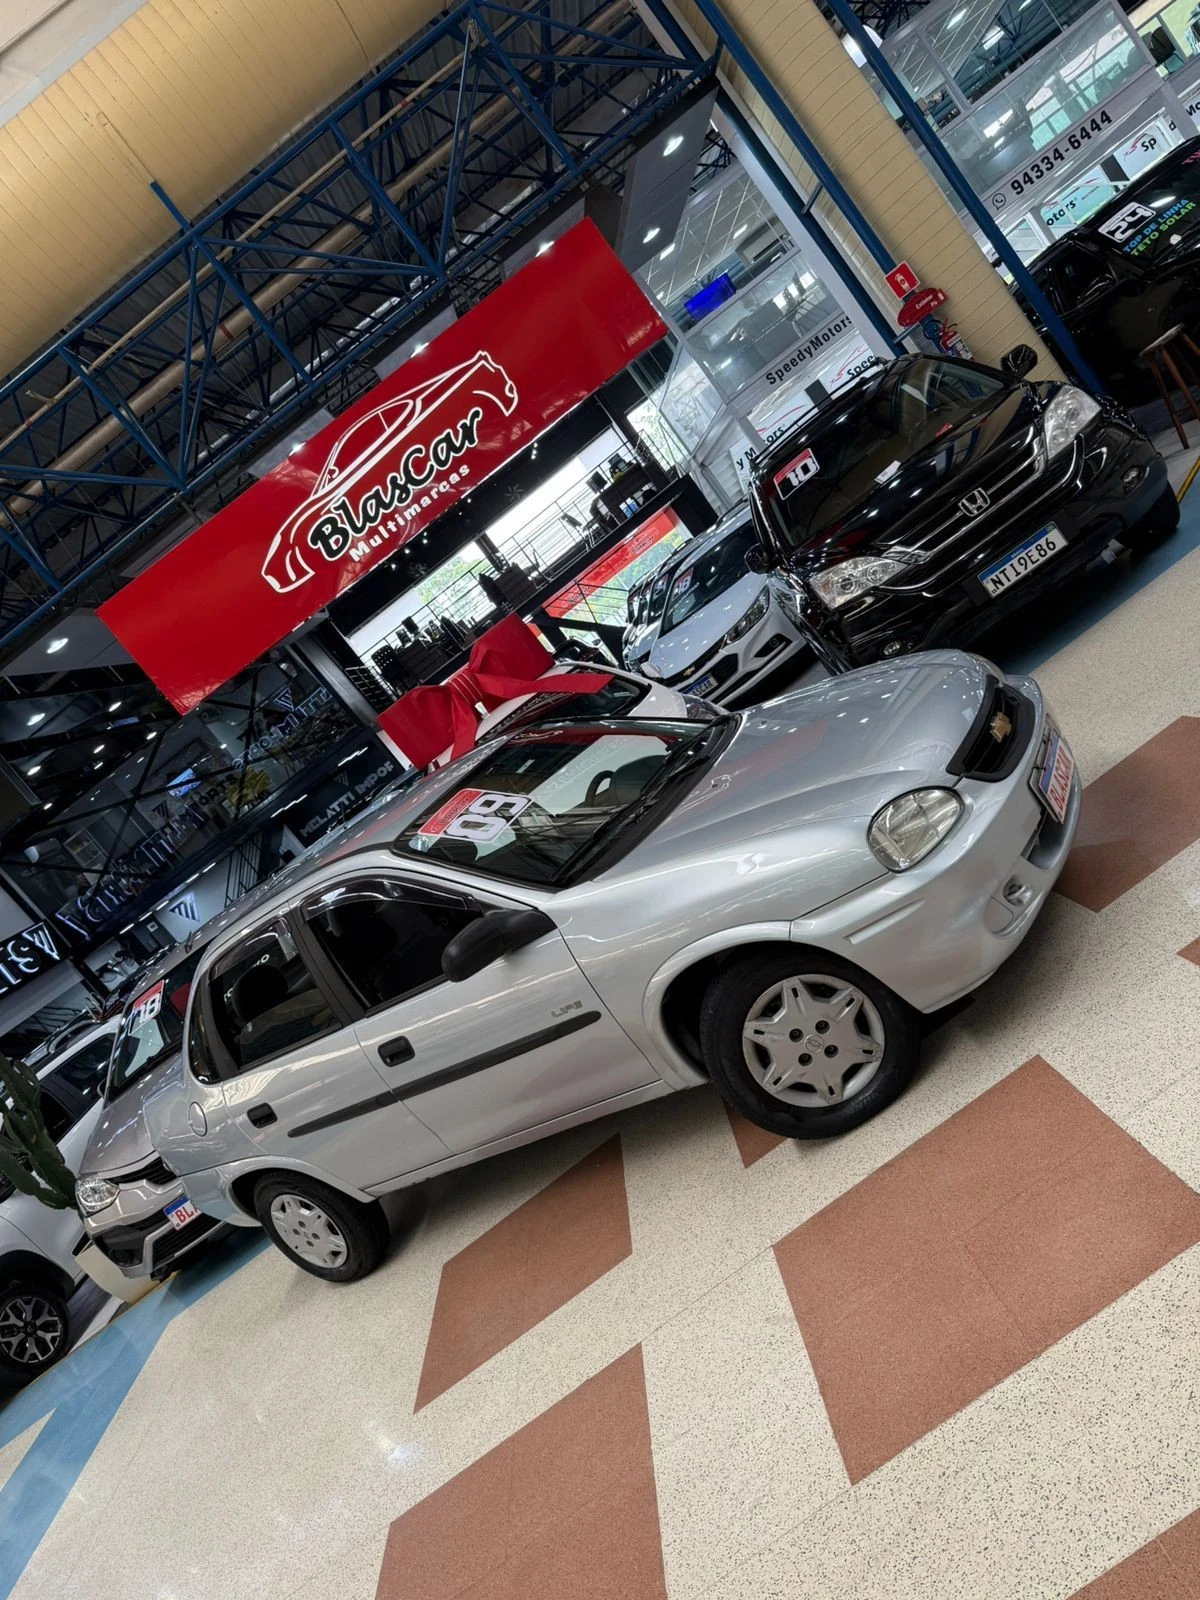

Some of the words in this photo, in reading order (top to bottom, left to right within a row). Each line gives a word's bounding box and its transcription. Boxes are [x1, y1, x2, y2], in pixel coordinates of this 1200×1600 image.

[1010, 109, 1113, 196] 94334-6444
[1108, 206, 1153, 241] 24
[1122, 234, 1143, 253] TOP
[1143, 222, 1158, 236] DE
[1158, 199, 1189, 223] LINHA
[1130, 231, 1159, 256] TETO
[1160, 201, 1197, 231] SOLAR
[765, 315, 852, 385] SpeedyMotors
[308, 407, 482, 560] BlasCar
[786, 457, 818, 486] 10
[349, 464, 470, 562] Multimarcas
[990, 537, 1056, 590] NTI9E86
[300, 792, 356, 838] MELATTI
[445, 793, 529, 841] 09
